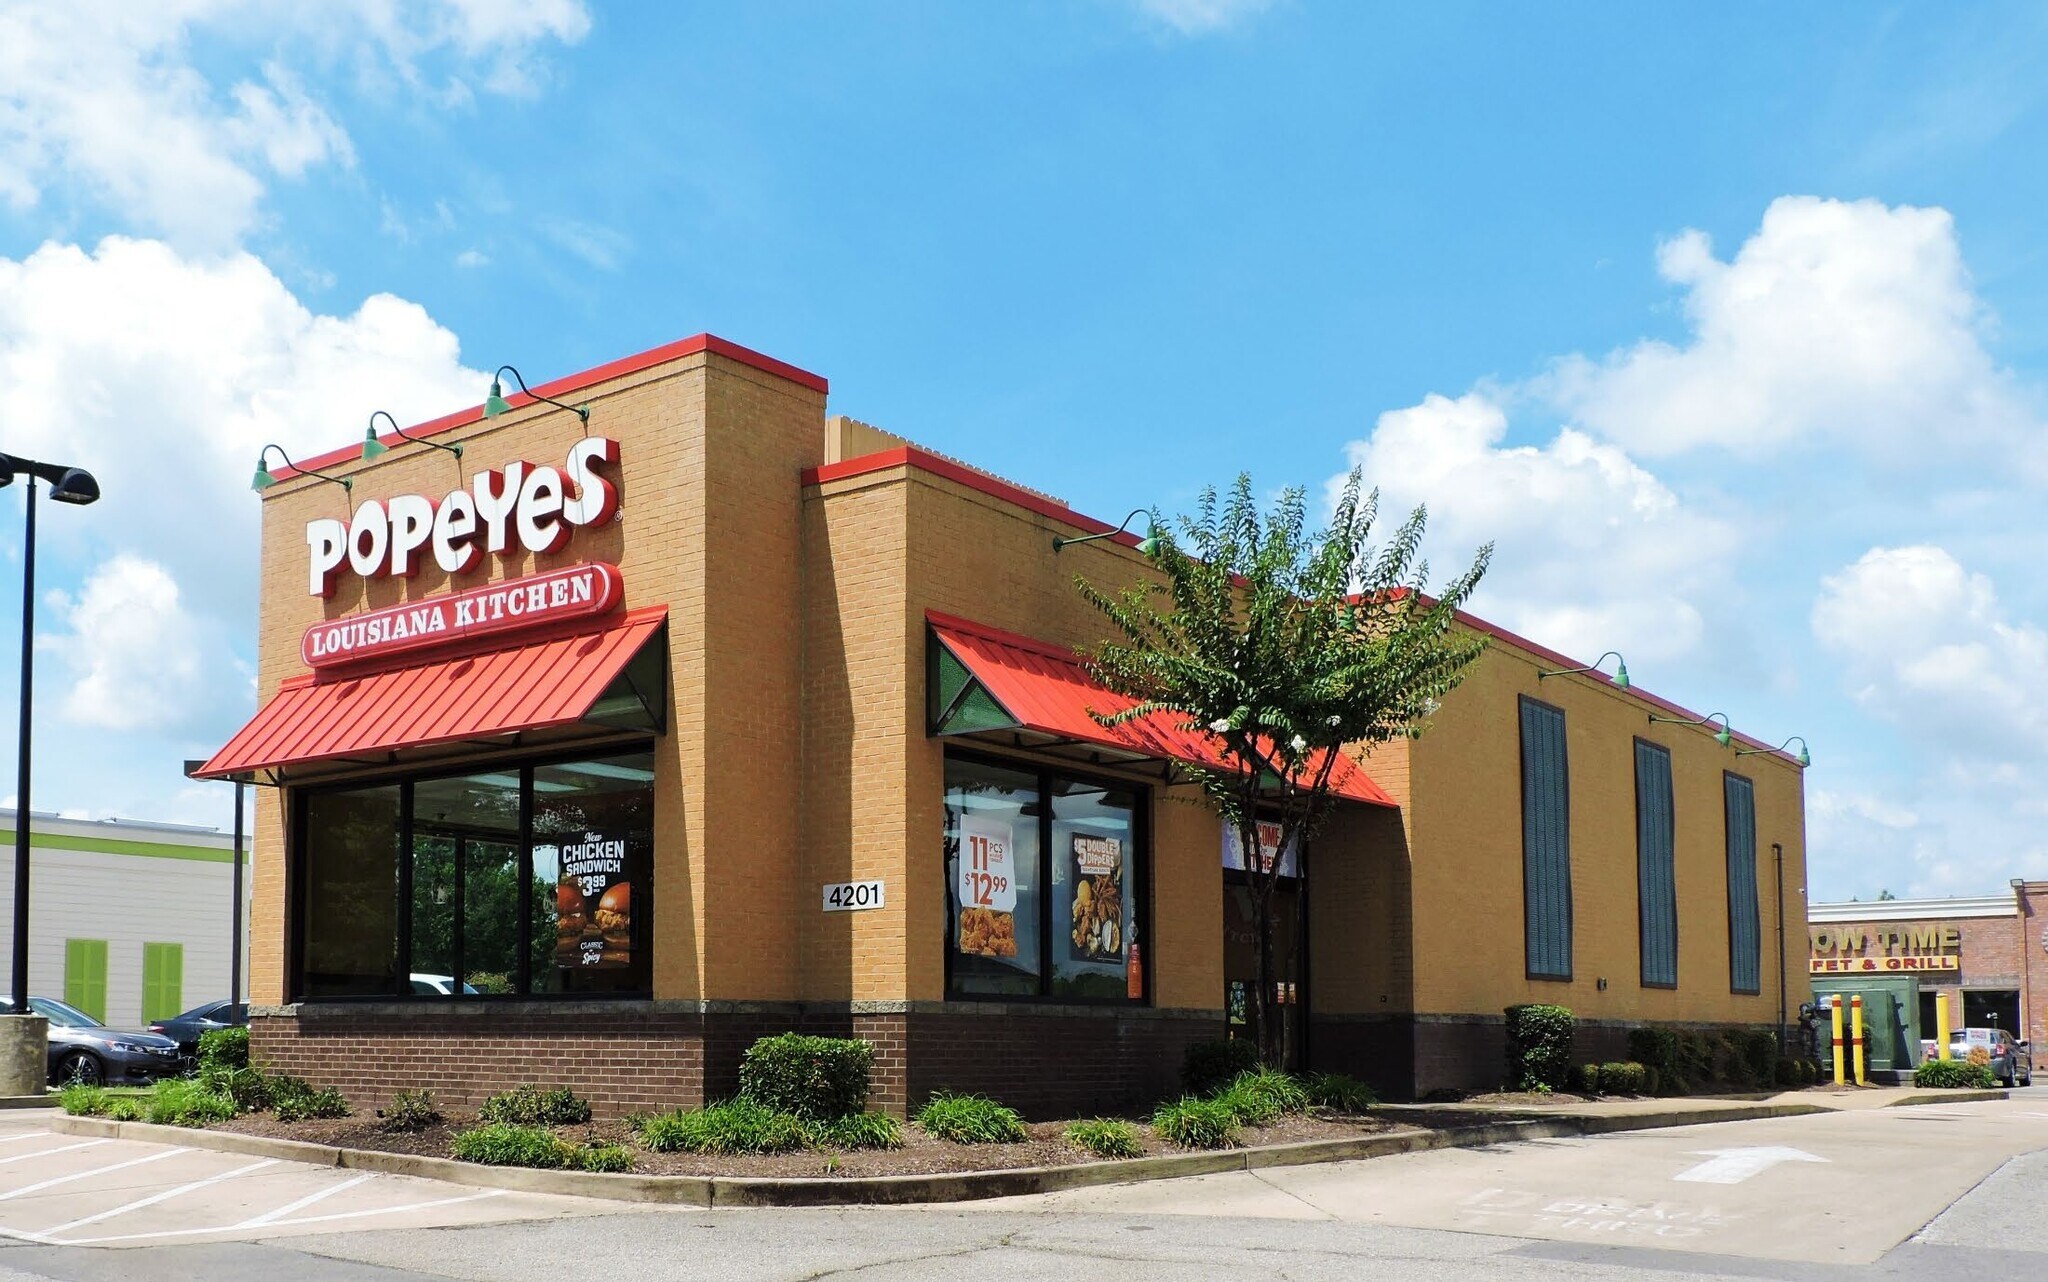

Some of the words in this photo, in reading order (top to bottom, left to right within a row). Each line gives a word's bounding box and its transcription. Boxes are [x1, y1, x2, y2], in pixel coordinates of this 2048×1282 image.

[311, 608, 445, 657] LOUISIANA
[455, 573, 594, 627] KITCHEN
[584, 831, 603, 843] New
[562, 840, 625, 863] CHICKEN
[969, 835, 988, 871] 11
[989, 842, 1004, 854] PCS
[1087, 839, 1114, 856] DOUBLE
[566, 859, 621, 877] SANDWICH
[829, 884, 878, 907] 4201
[580, 941, 604, 950] CLASSIC
[1811, 927, 1867, 953] OW
[1877, 923, 1960, 949] TIME
[582, 951, 601, 965] Spicy
[1812, 959, 1852, 971] FET
[1862, 959, 1877, 971] &
[1886, 957, 1954, 970] GRILL
